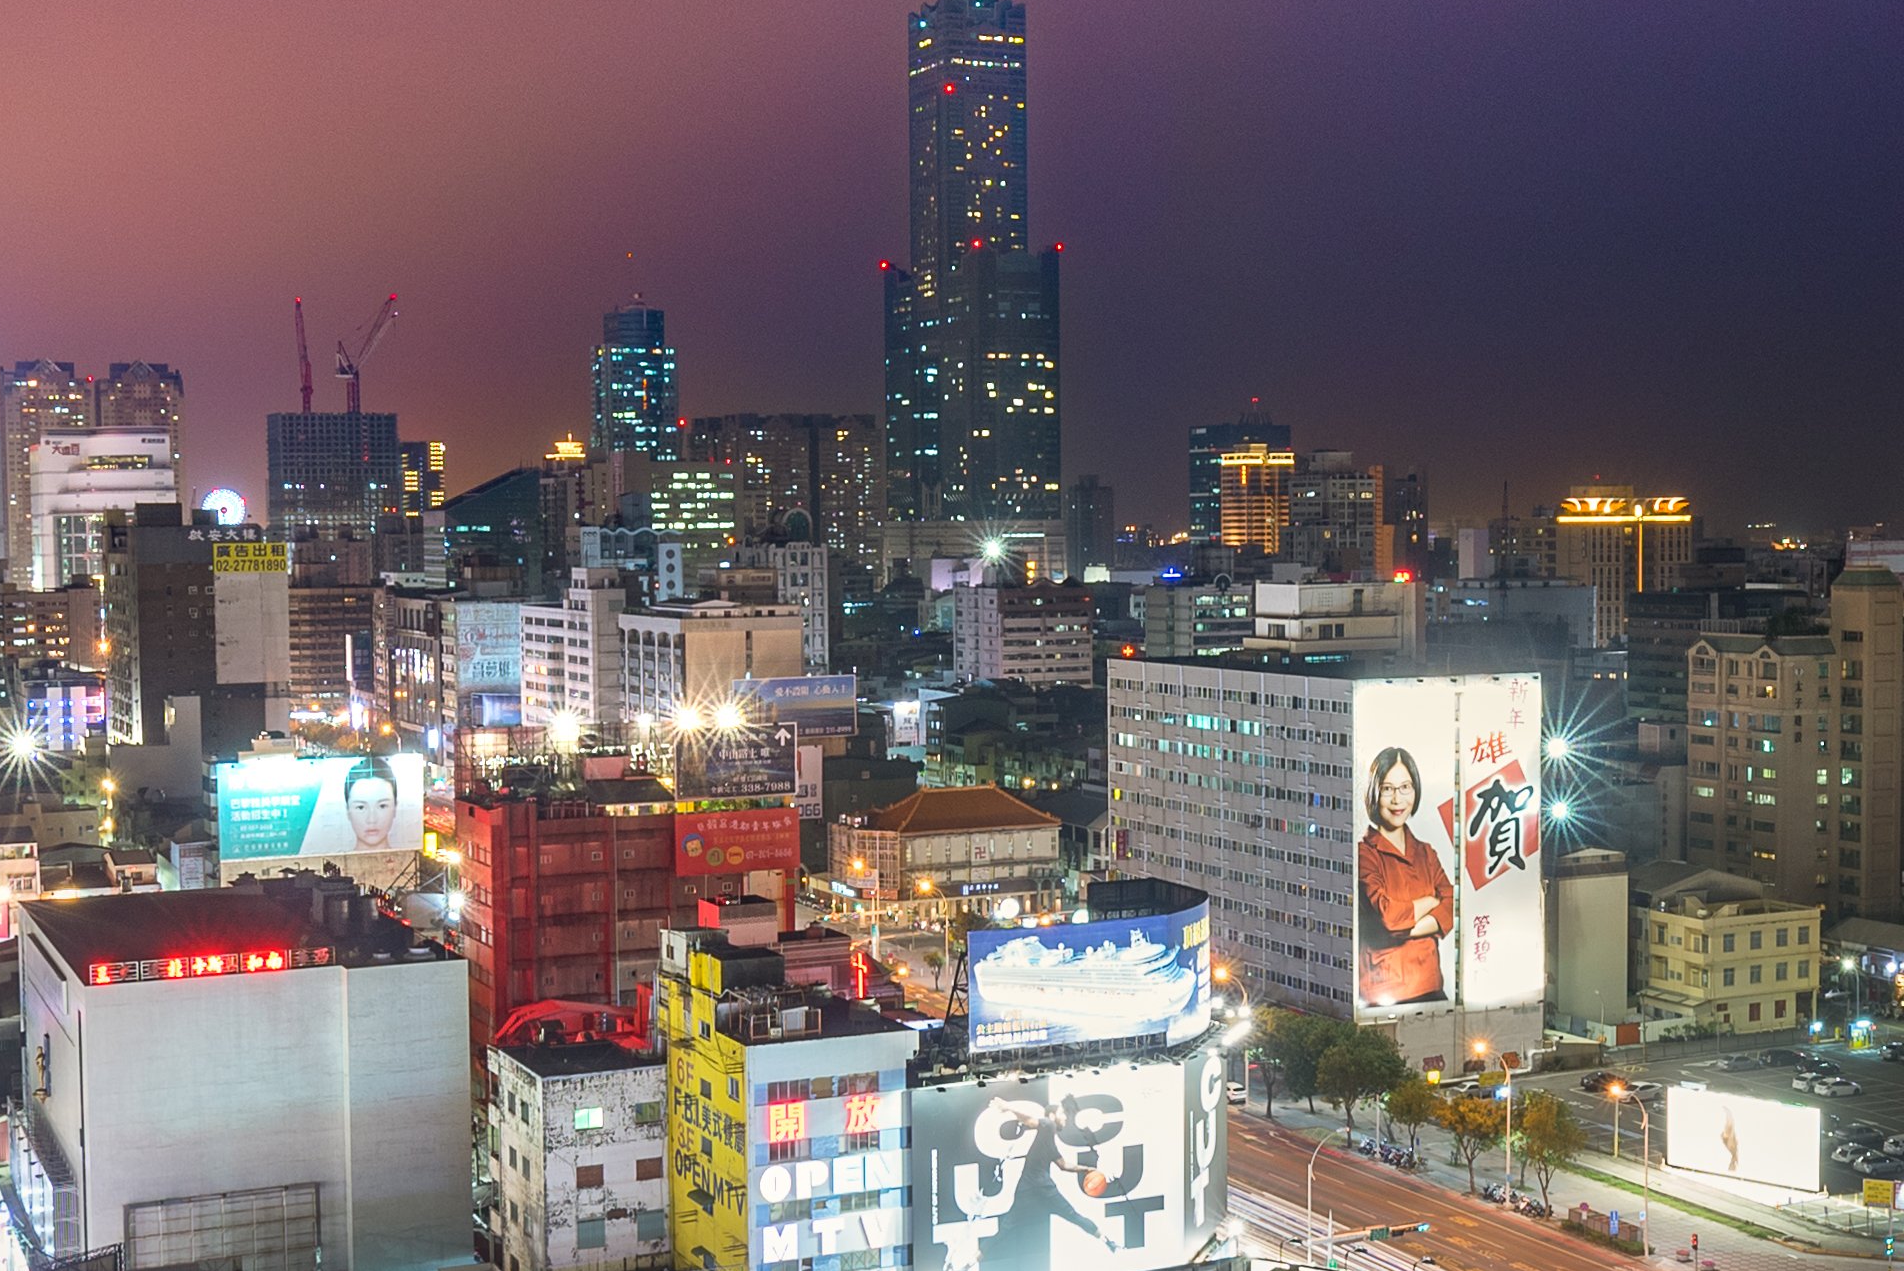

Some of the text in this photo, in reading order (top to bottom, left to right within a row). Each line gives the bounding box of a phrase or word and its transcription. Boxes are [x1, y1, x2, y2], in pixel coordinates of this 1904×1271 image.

[216, 544, 285, 557] 廣告出租
[216, 559, 286, 572] 02-27781890
[1507, 678, 1528, 729] 新年
[1470, 730, 1512, 764] 雄
[1470, 779, 1534, 875] 賀
[677, 1057, 694, 1088] 6F
[769, 1095, 881, 1142] 開放
[675, 1149, 747, 1217] OPEN MTV
[759, 1151, 897, 1203] OPEN
[763, 1210, 894, 1263] MTV
